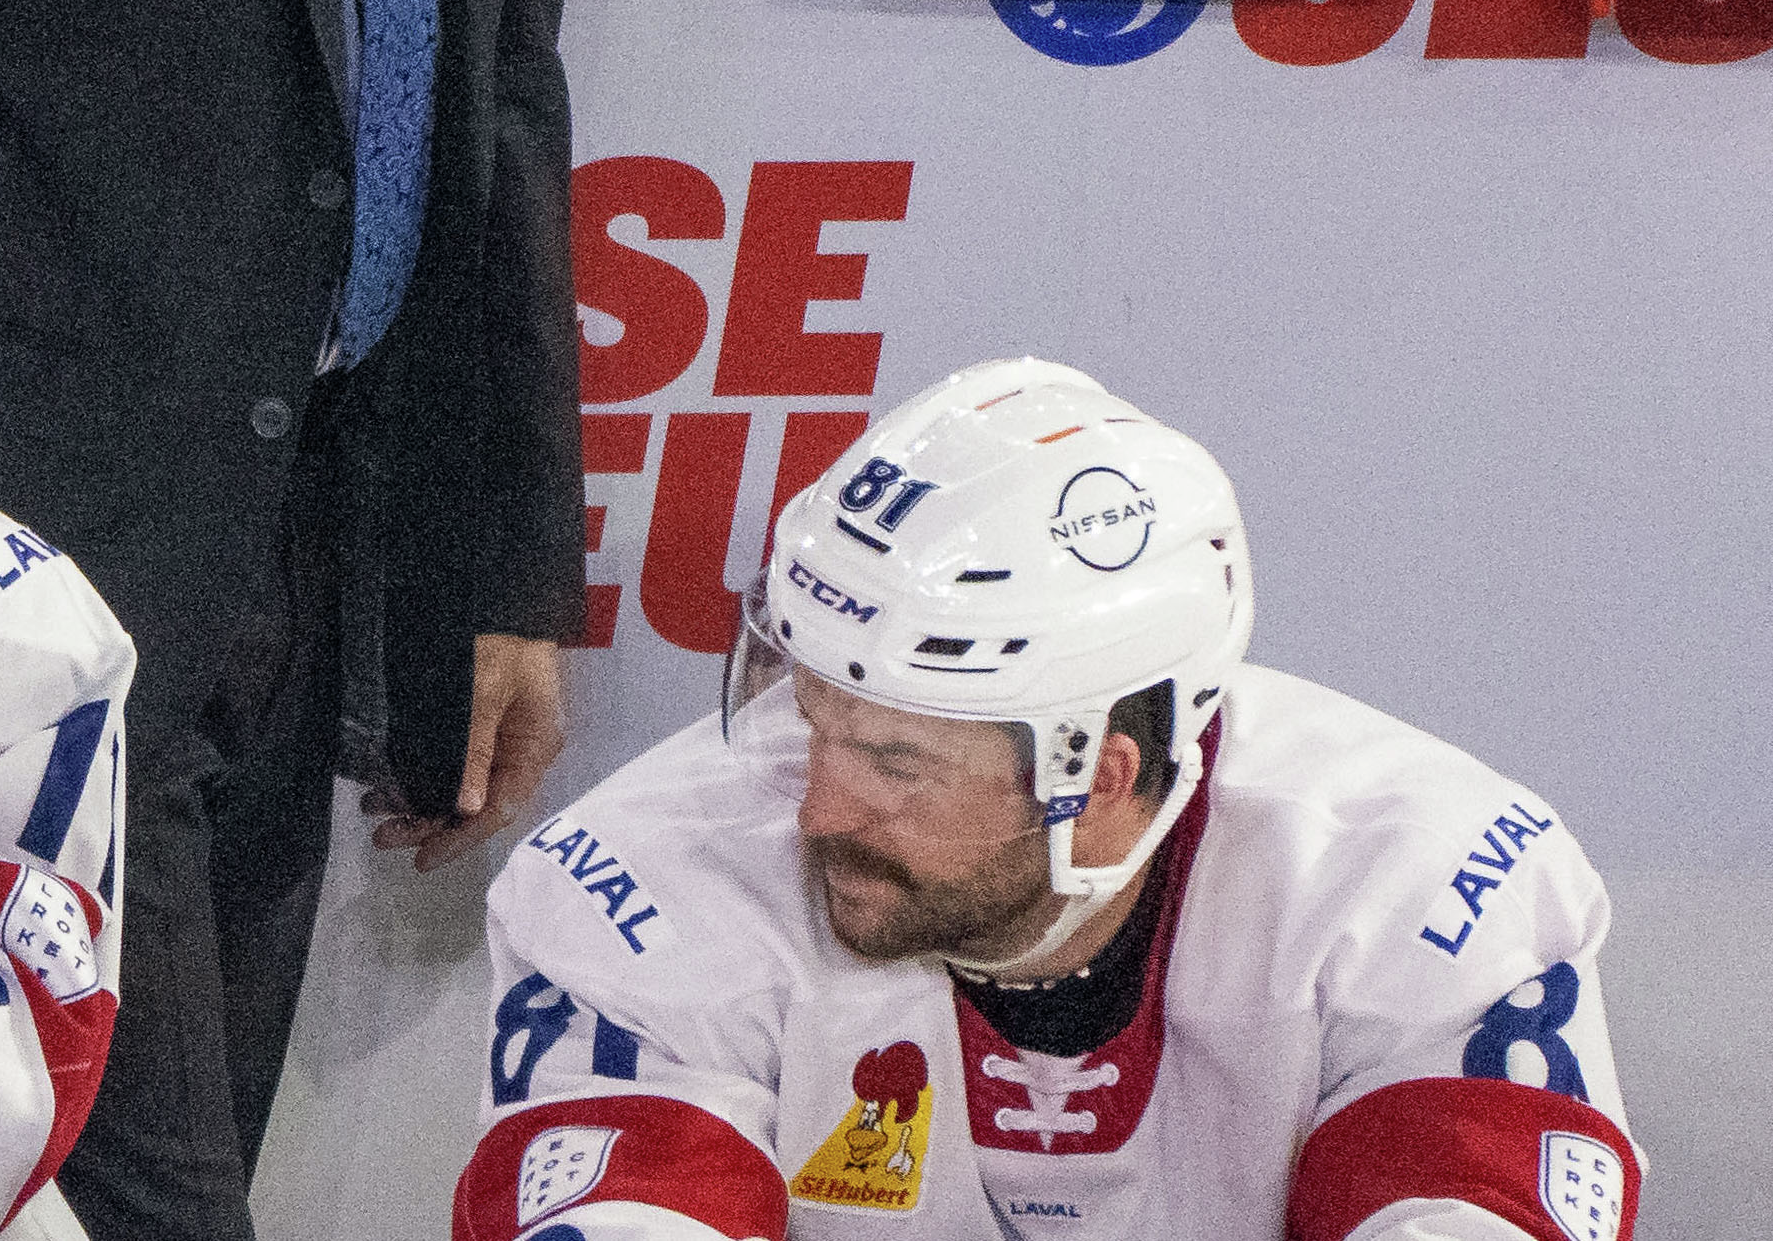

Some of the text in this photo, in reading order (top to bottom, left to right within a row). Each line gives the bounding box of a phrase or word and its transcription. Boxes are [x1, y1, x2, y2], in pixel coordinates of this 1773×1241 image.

[837, 456, 940, 534] 81
[1049, 496, 1157, 543] NISSAN
[787, 560, 880, 624] CCM
[529, 819, 660, 955] LAVAL
[1420, 803, 1554, 957] LAVAL
[1462, 961, 1589, 1103] 8
[1010, 1201, 1081, 1218] LAVAL
